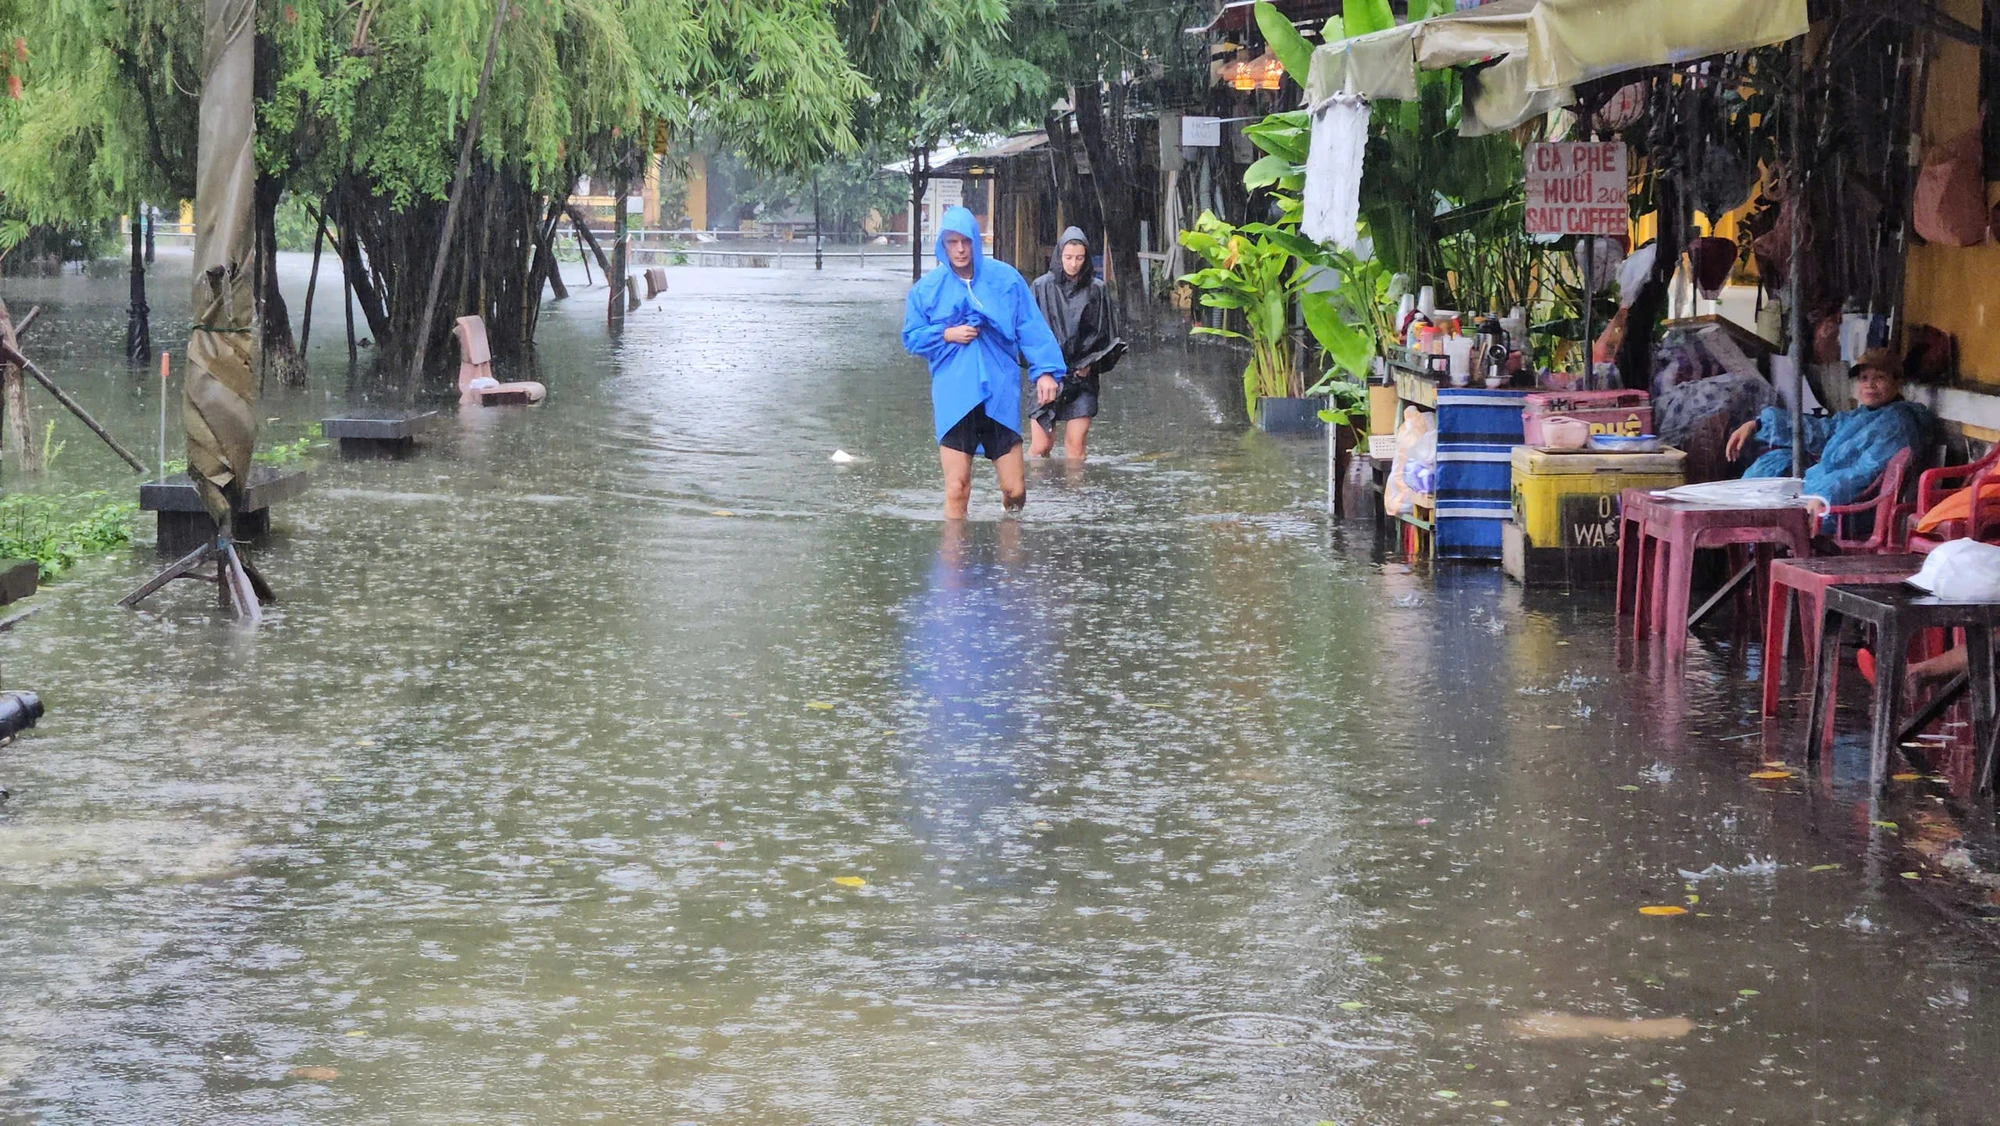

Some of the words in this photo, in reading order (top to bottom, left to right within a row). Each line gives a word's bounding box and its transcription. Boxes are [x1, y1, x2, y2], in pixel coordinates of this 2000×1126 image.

[1573, 142, 1616, 172] PHÊ
[1526, 207, 1563, 233] SALT
[1567, 207, 1626, 233] COFFEE
